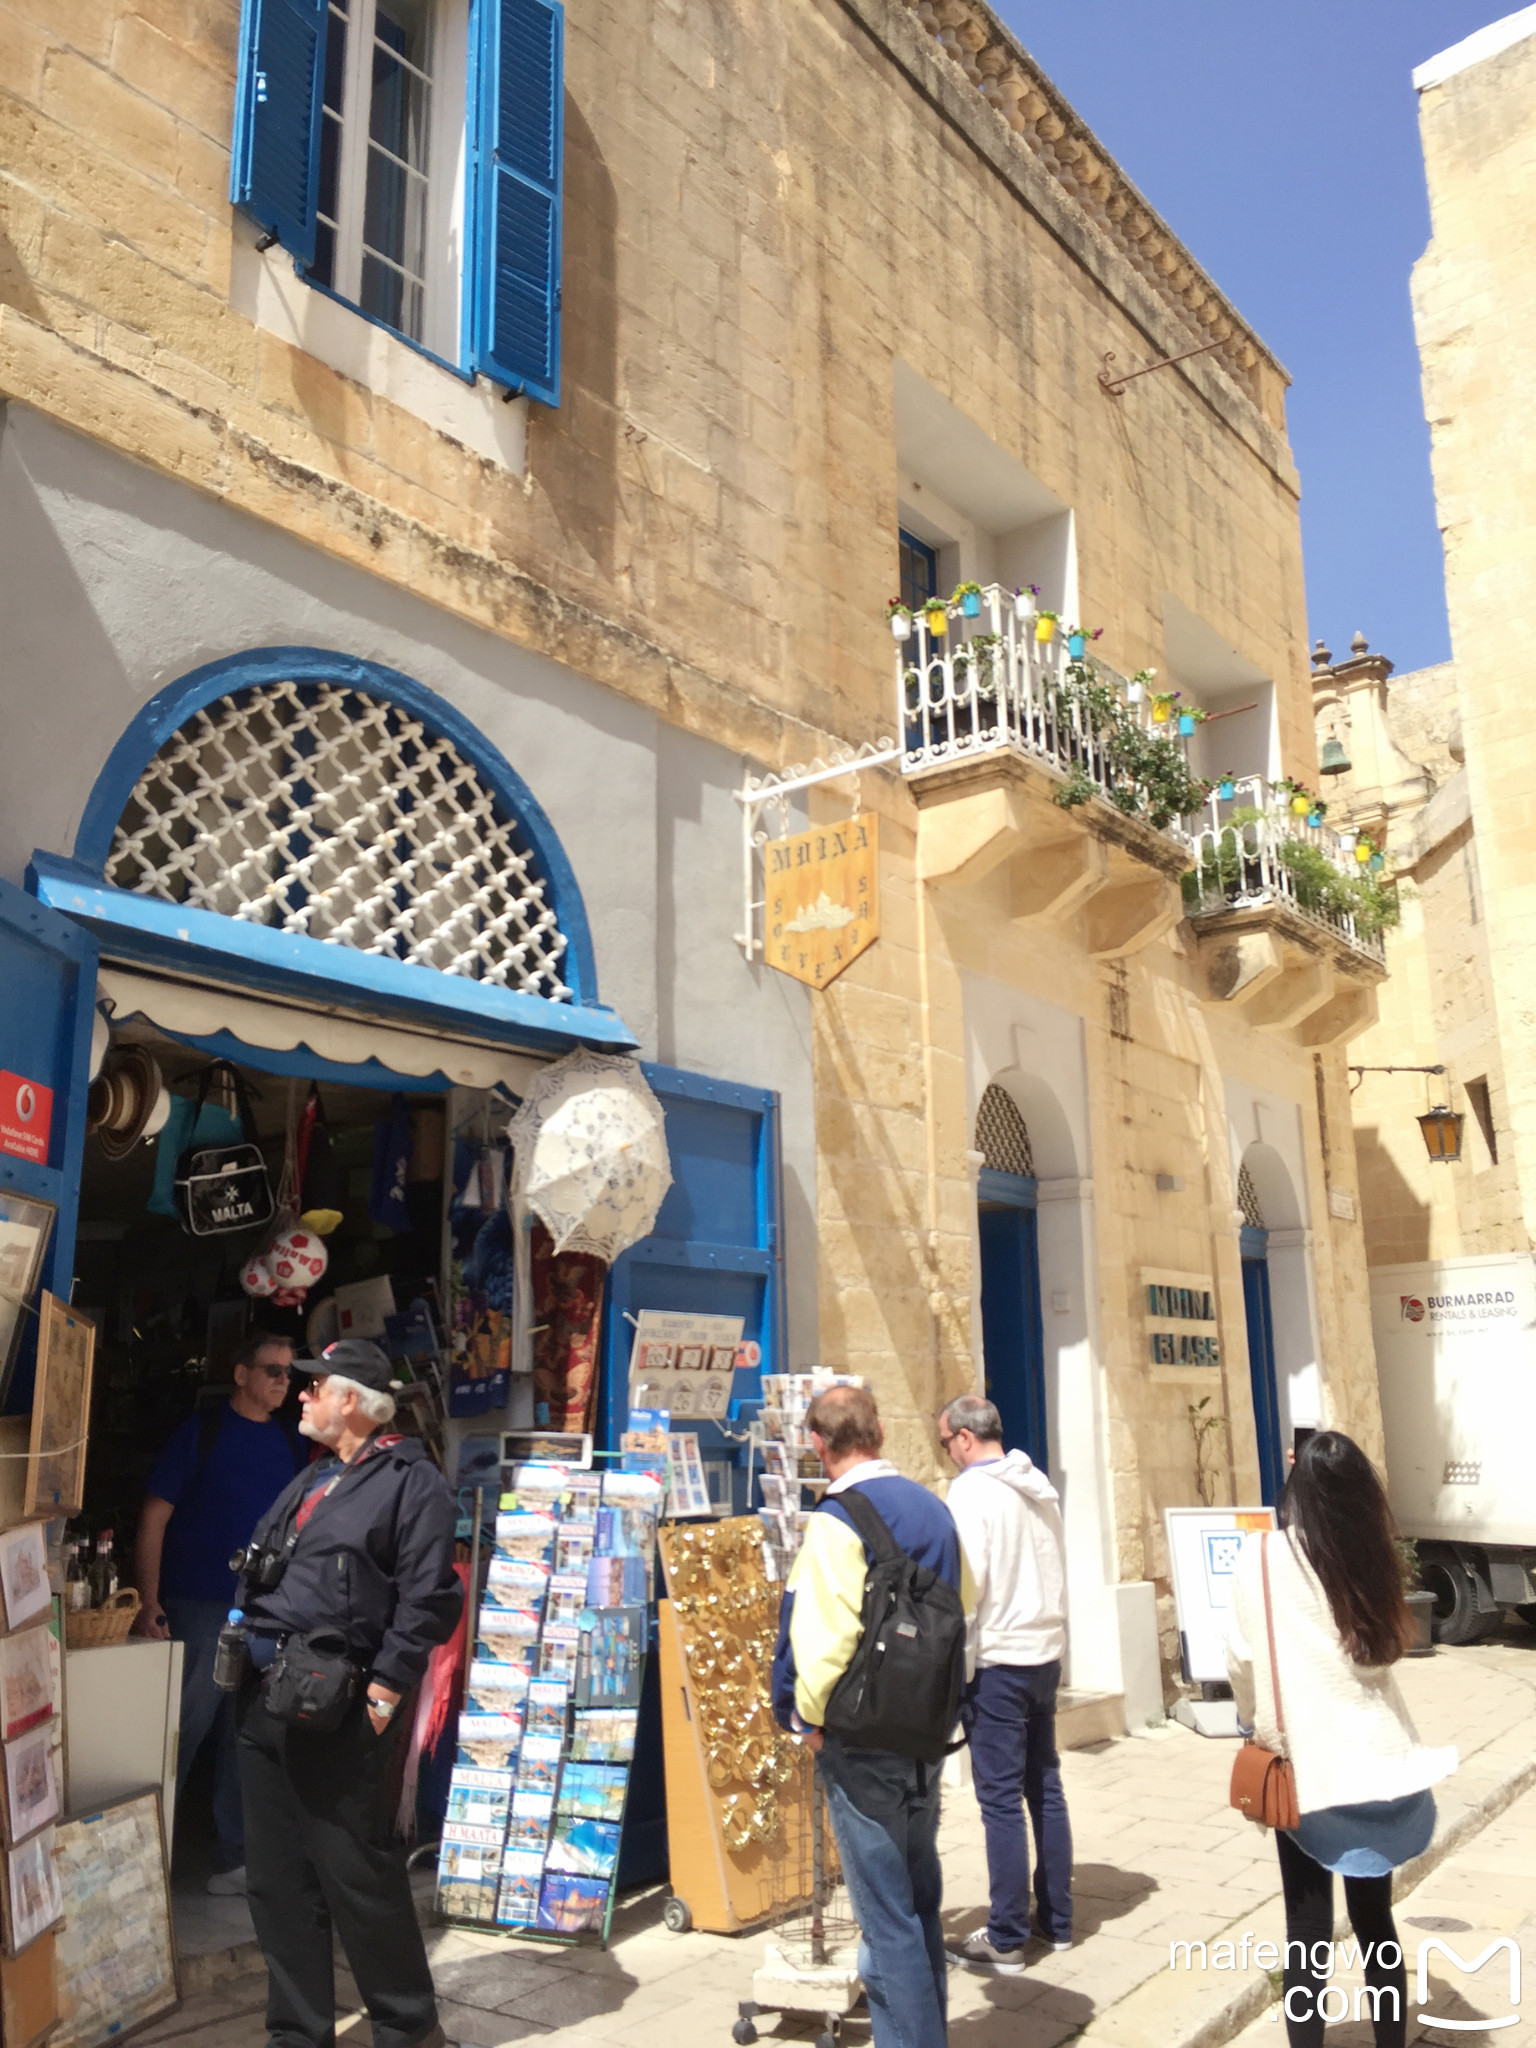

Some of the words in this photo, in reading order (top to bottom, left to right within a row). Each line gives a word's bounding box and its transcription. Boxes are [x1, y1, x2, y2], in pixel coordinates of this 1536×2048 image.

[772, 825, 869, 874] MDINA
[211, 1201, 254, 1223] MALTA
[1427, 1291, 1515, 1309] BURMARRAD
[1430, 1309, 1467, 1322] RENTALS
[1479, 1306, 1518, 1319] LEASING
